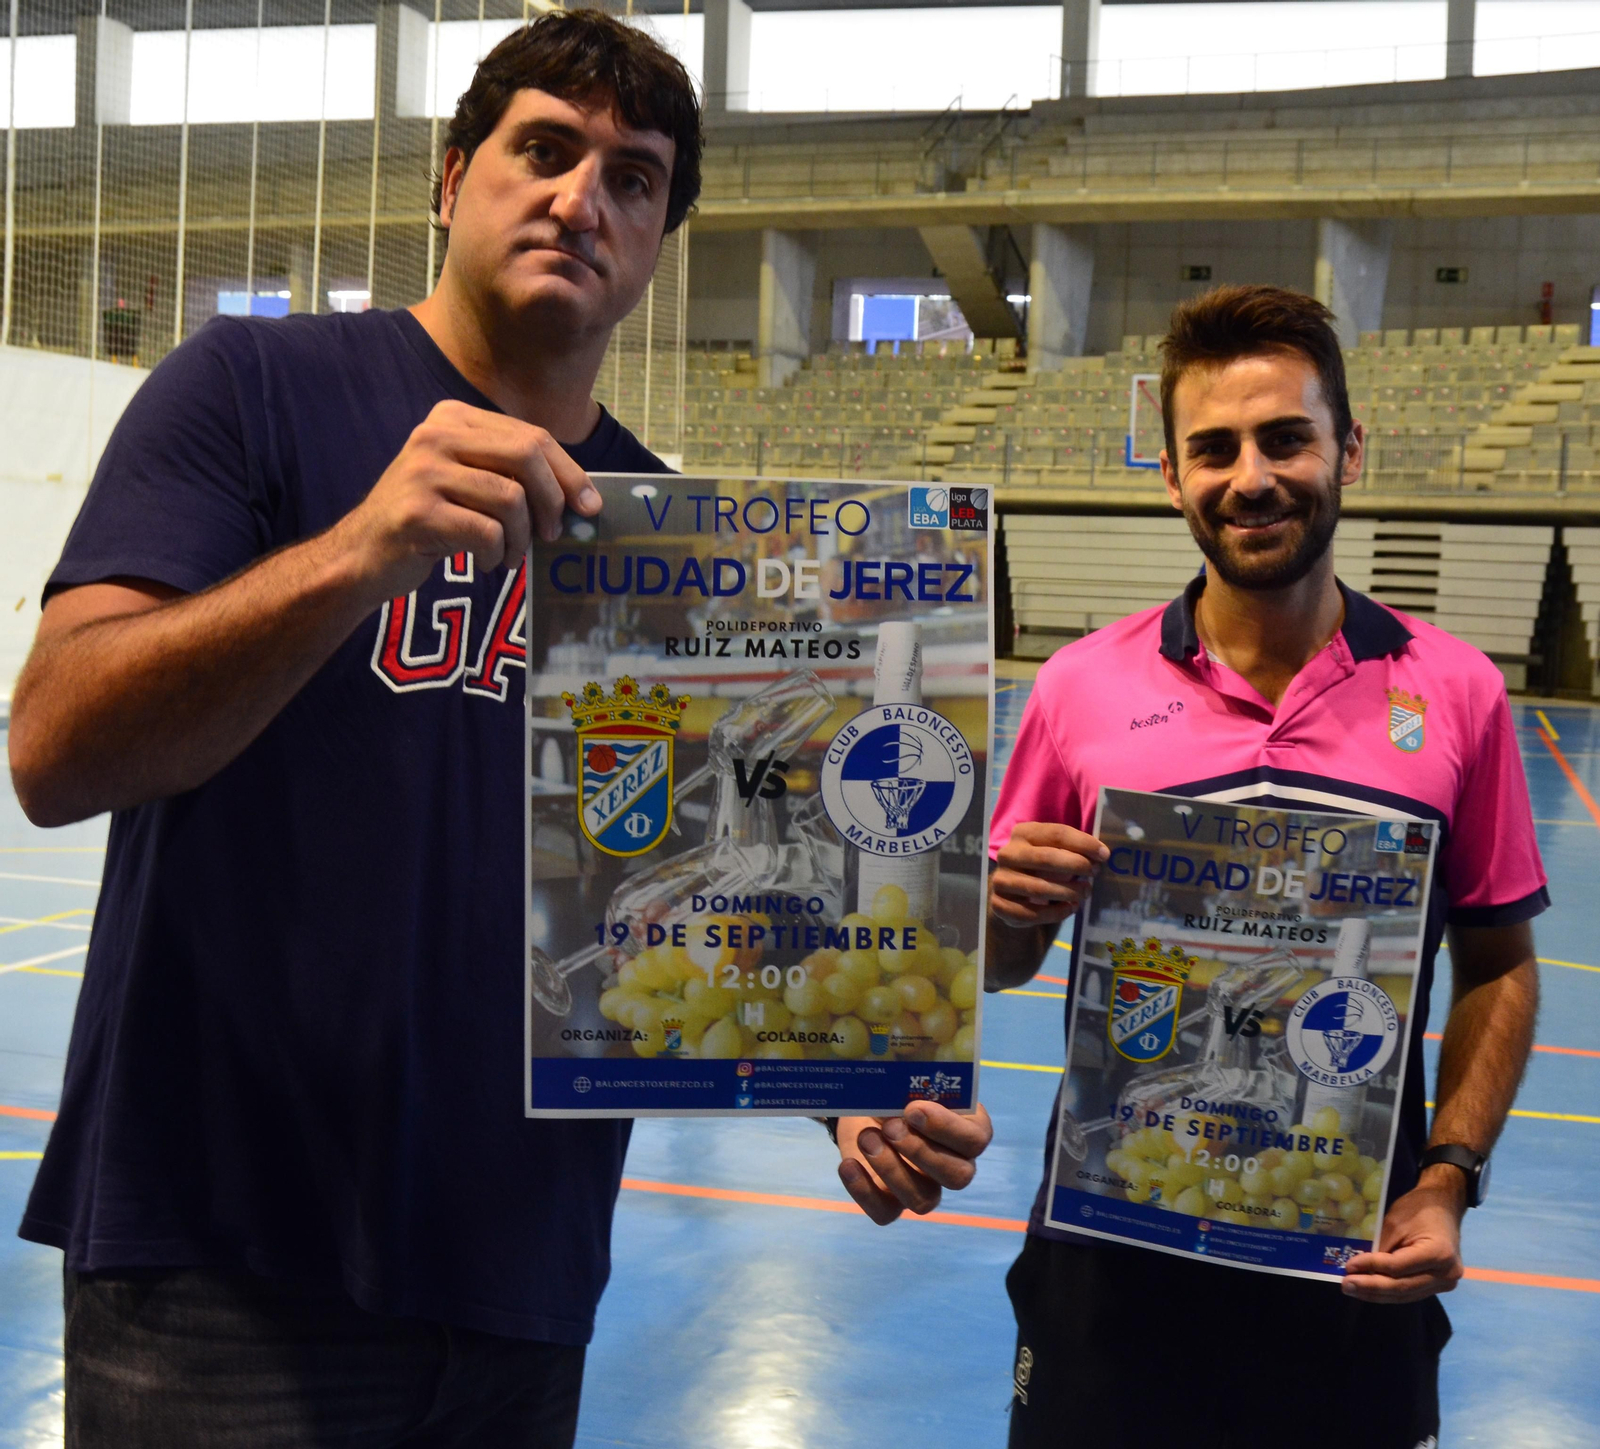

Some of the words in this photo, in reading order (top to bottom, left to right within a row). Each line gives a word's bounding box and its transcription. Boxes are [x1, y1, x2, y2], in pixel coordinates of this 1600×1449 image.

[951, 492, 967, 503] Liga
[643, 494, 673, 532] V
[687, 494, 871, 537] TROFEO
[913, 513, 940, 525] EBA
[951, 507, 975, 518] LEB
[951, 518, 984, 528] PLATA
[549, 553, 746, 598] CIUDAD
[757, 558, 821, 599] DE
[829, 560, 974, 602] JEREZ
[706, 620, 823, 633] POLIDEPORTIVO
[664, 631, 732, 658] RUÍZ
[744, 637, 862, 660] MATEOS
[828, 725, 860, 765] CLUB
[883, 707, 971, 775] BALONCESTO
[592, 744, 664, 827] XEREZ
[732, 751, 790, 807] VS
[845, 823, 946, 854] MARBELLA
[1181, 811, 1203, 840] V
[1214, 816, 1347, 856] TROFEO
[1377, 839, 1398, 850] EBA
[1107, 847, 1250, 892] CIUDAD
[1256, 866, 1306, 898] DE
[1309, 872, 1417, 906] JEREZ
[691, 894, 825, 915] DOMINGO
[1216, 905, 1302, 924] POLIDEPORTIVO
[594, 922, 630, 947] 19
[647, 923, 687, 948] DE
[703, 924, 917, 951] SEPTIEMBRE
[1242, 919, 1328, 943] MATEOS
[704, 964, 808, 991] 12:00
[743, 1003, 764, 1026] H
[1115, 989, 1175, 1038] XEREZ
[1294, 989, 1320, 1018] CLUB
[1337, 980, 1396, 1032] BALONCESTO
[561, 1029, 649, 1042] ORGANIZA:
[1224, 1002, 1266, 1042] VS
[756, 1031, 845, 1044] COLABORA:
[1300, 1060, 1375, 1085] MARBELLA
[1181, 1096, 1279, 1124] DOMINGO
[1109, 1102, 1134, 1121] 19
[1145, 1110, 1174, 1132] DE
[1186, 1119, 1345, 1157] SEPTIEMBRE
[1184, 1148, 1260, 1175] 12:00
[1076, 1169, 1139, 1192] ORGANIZA:
[1216, 1200, 1282, 1219] COLABORA:
